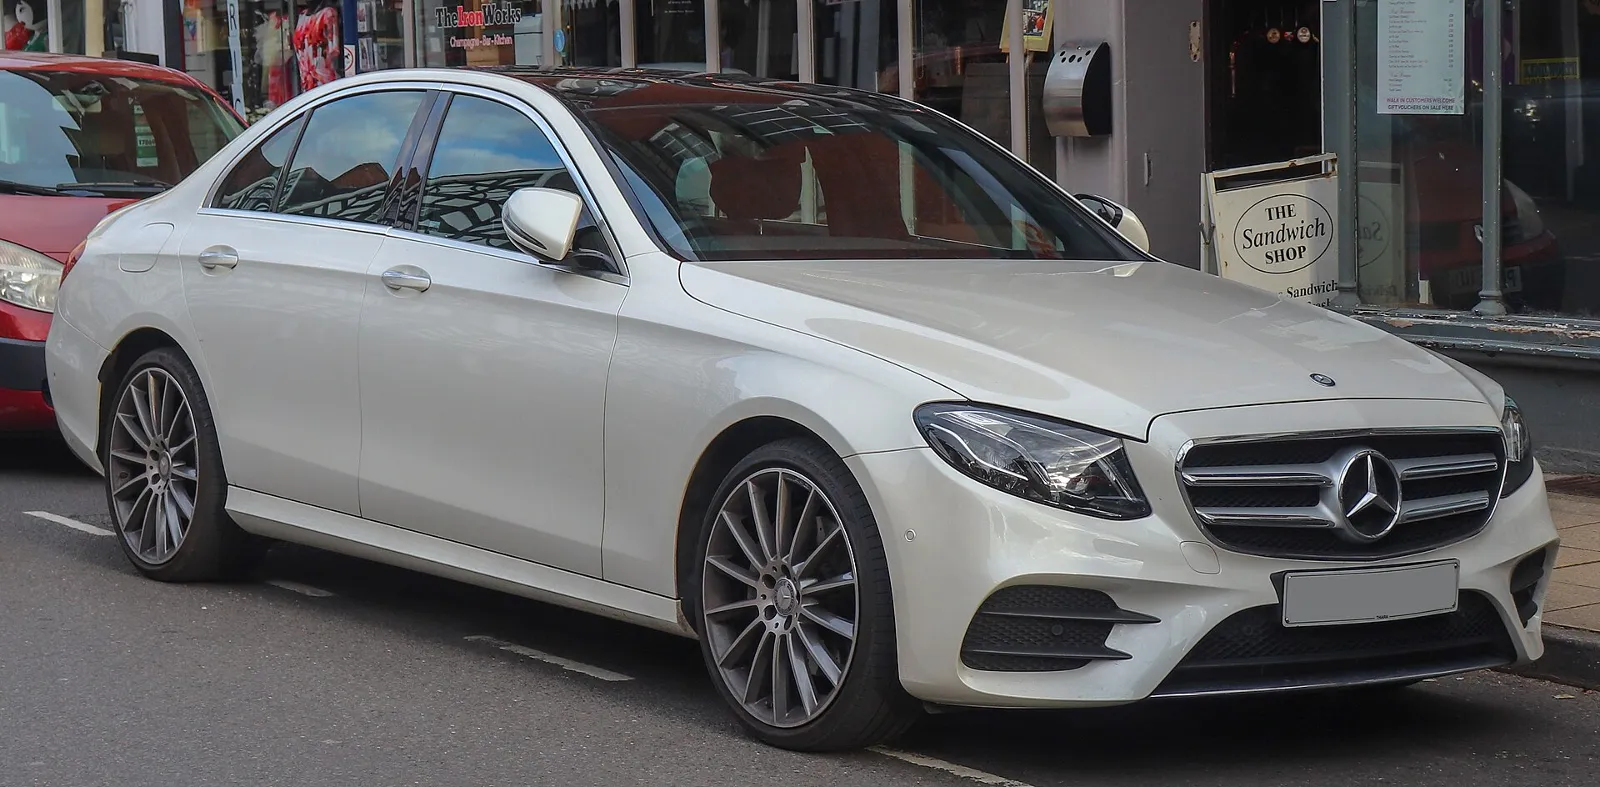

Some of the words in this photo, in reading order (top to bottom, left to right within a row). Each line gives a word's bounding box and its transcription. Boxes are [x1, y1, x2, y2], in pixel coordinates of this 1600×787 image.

[1265, 204, 1297, 221] THE
[1242, 217, 1326, 250] Sandwich
[1265, 245, 1307, 265] SHOP
[1286, 279, 1339, 299] Sandwich
